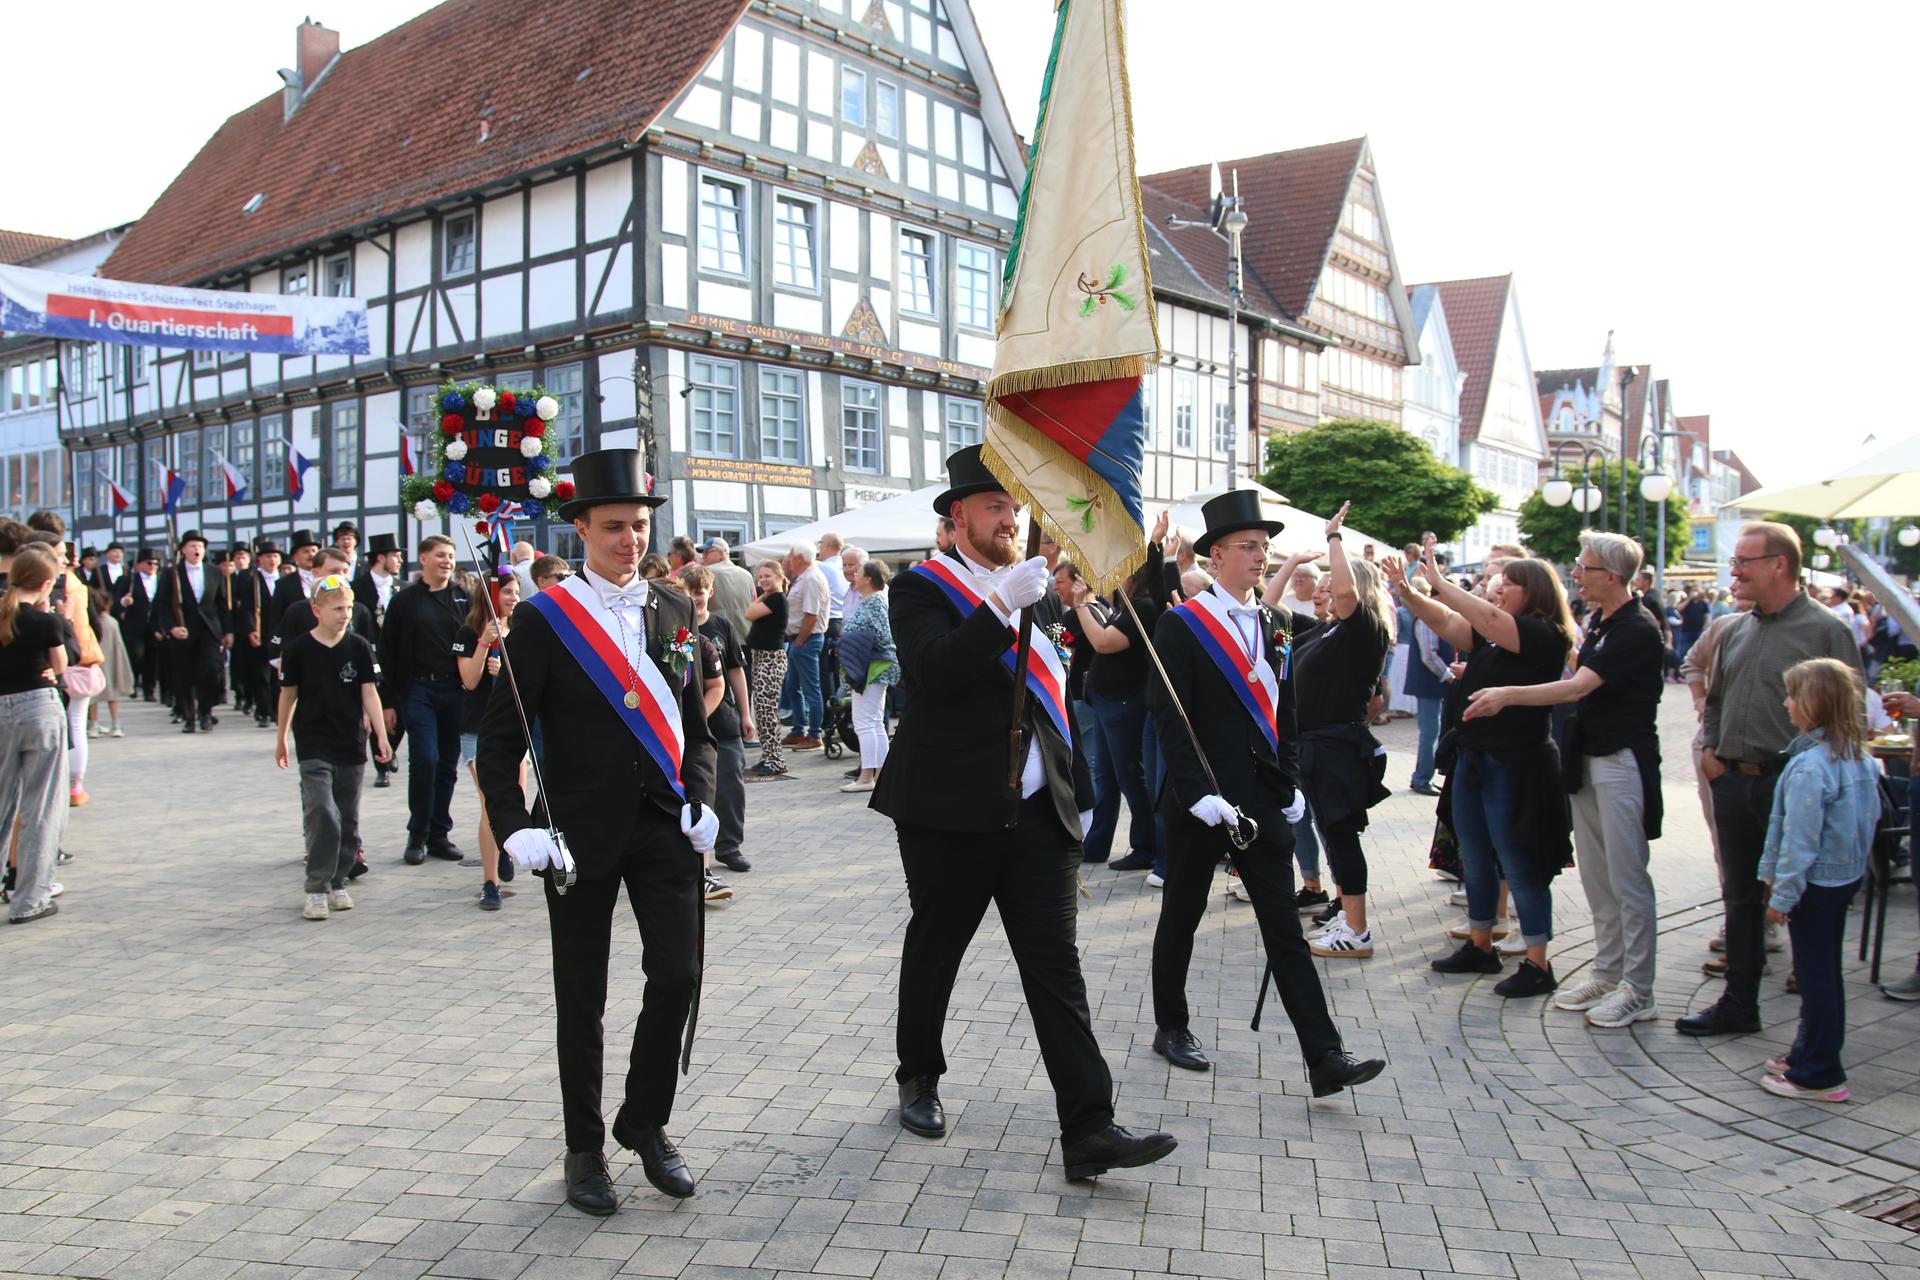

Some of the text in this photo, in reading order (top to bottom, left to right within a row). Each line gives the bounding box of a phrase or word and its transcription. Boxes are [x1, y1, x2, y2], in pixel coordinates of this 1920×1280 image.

[141, 291, 214, 308] Schützenfest
[216, 299, 278, 312] Stadthagen
[107, 311, 259, 341] Quartierschaft
[688, 314, 736, 332] DOMINE
